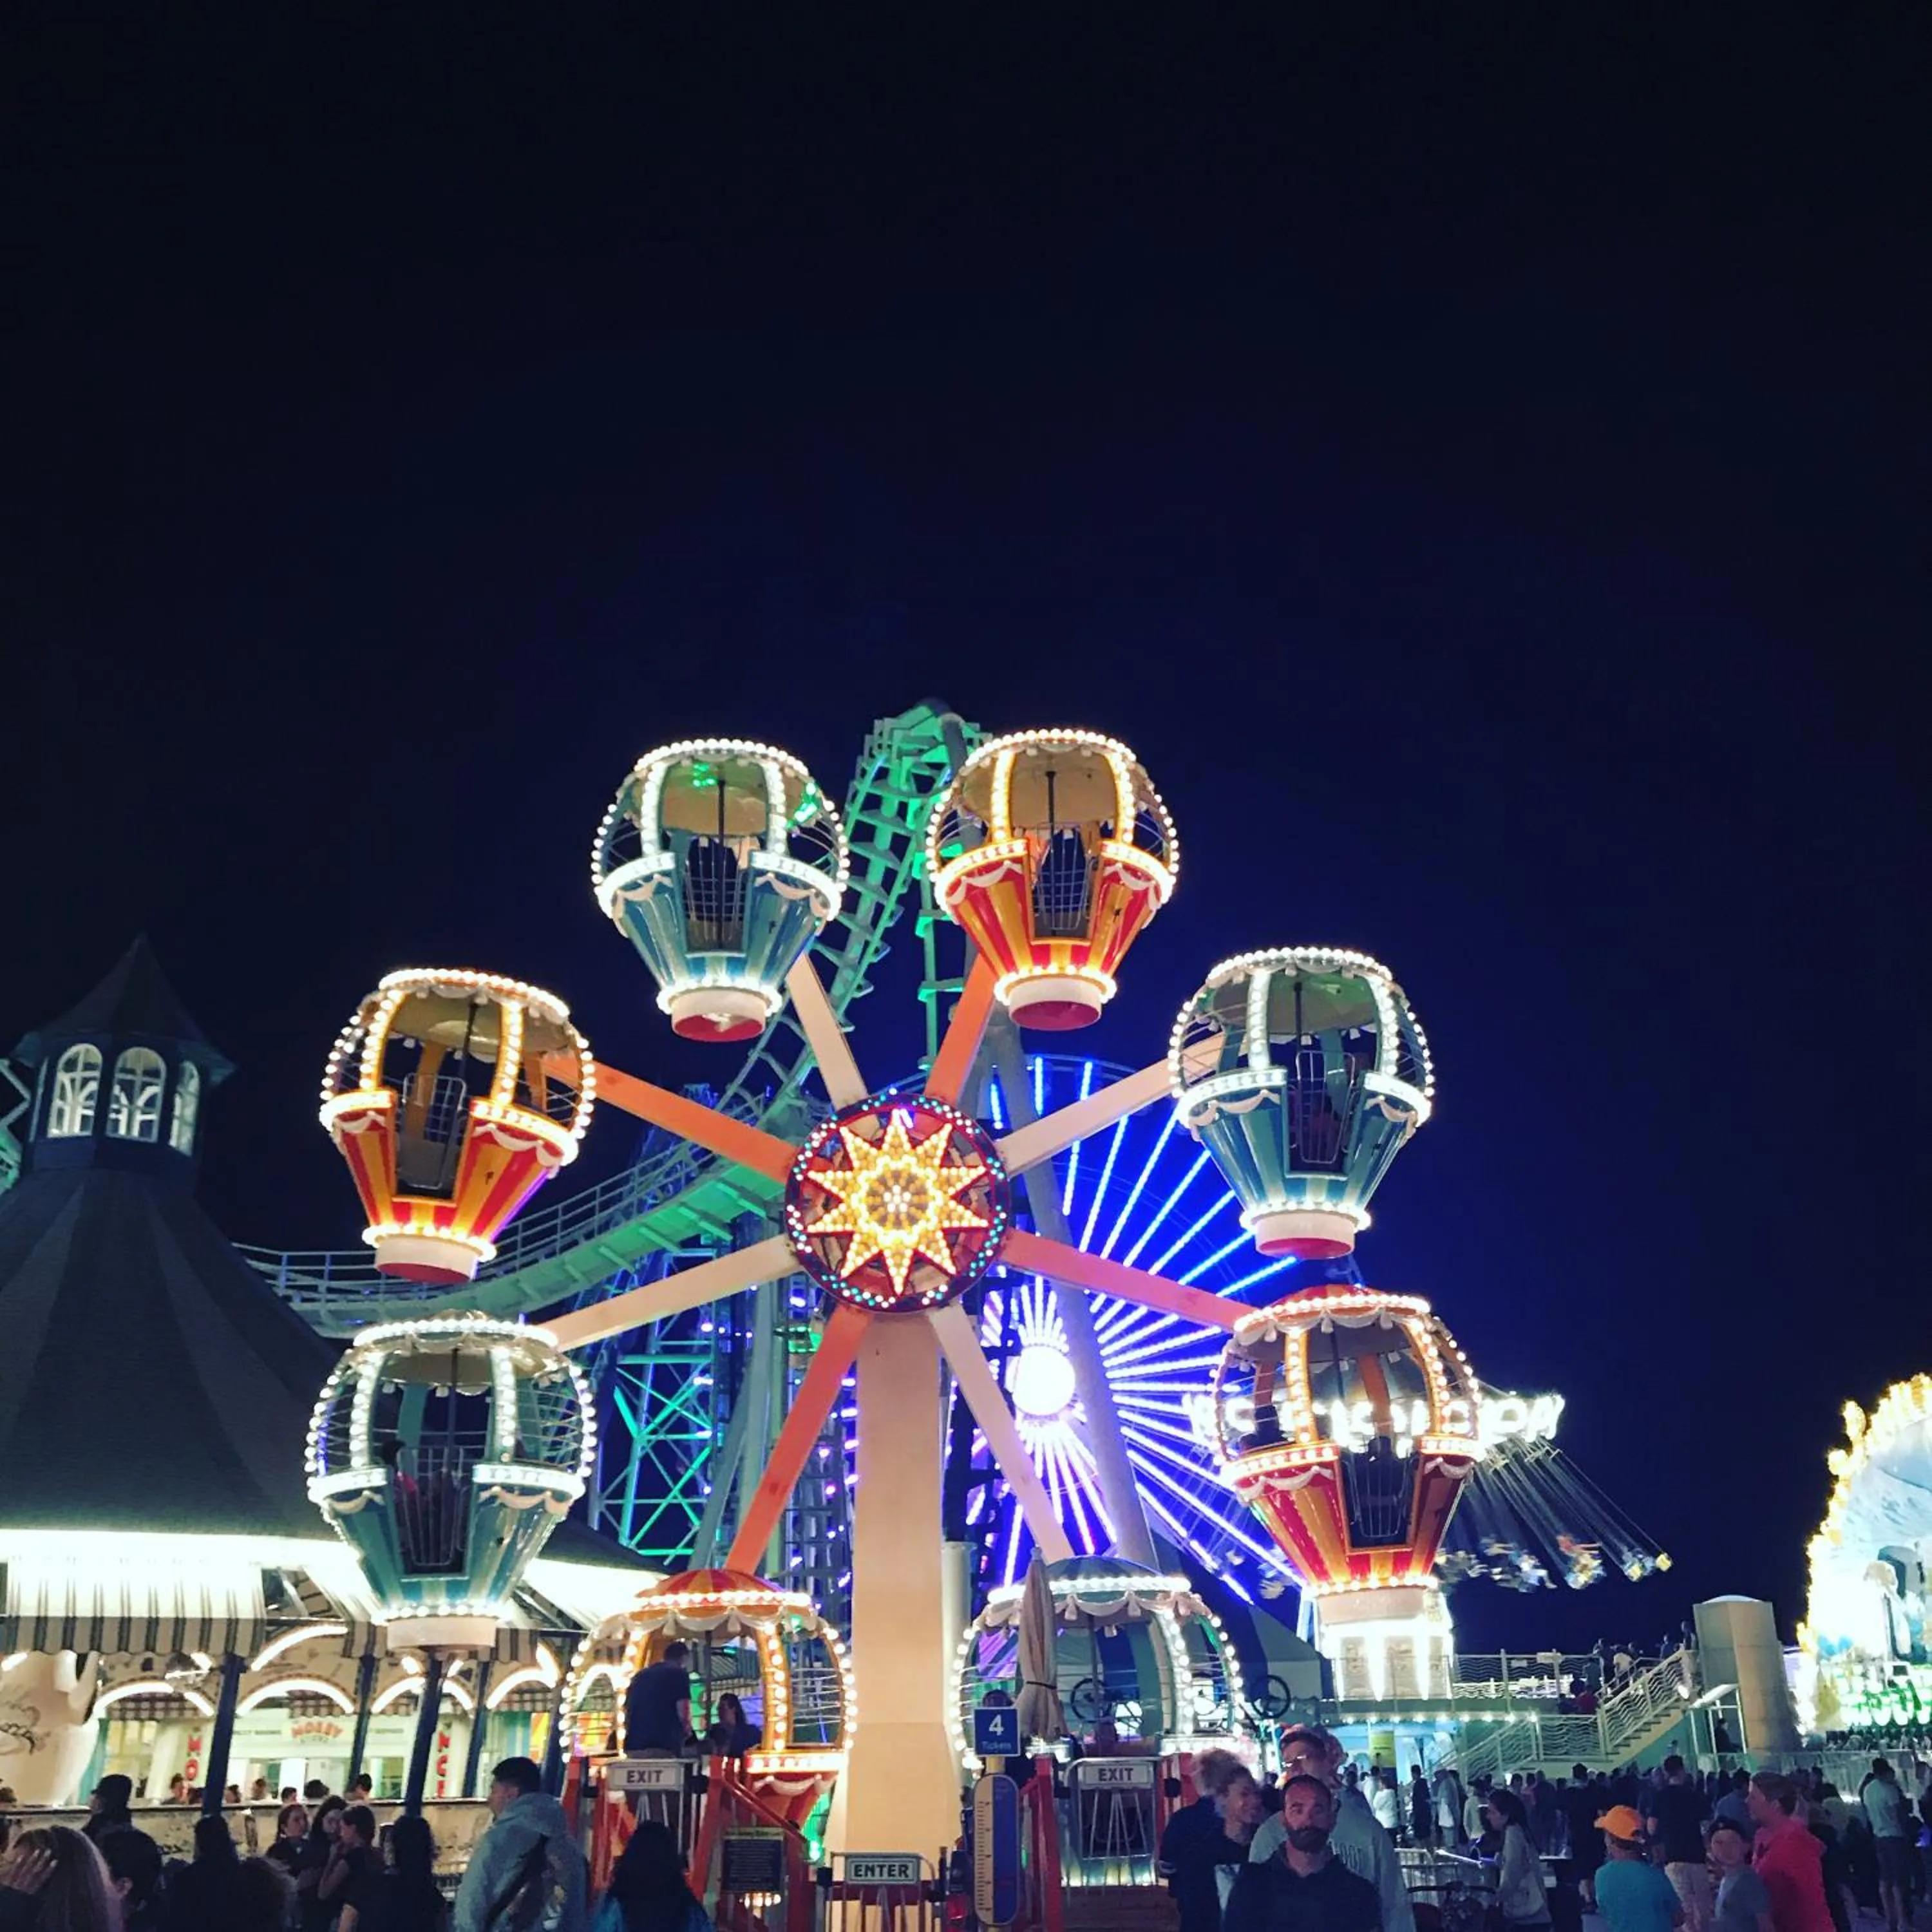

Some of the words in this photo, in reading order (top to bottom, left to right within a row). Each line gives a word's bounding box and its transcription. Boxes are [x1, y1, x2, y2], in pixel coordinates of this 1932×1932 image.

[989, 1714, 1004, 1736] 4
[627, 1770, 663, 1783] EXIT
[1098, 1768, 1133, 1781] EXIT
[854, 1864, 909, 1878] ENTER
